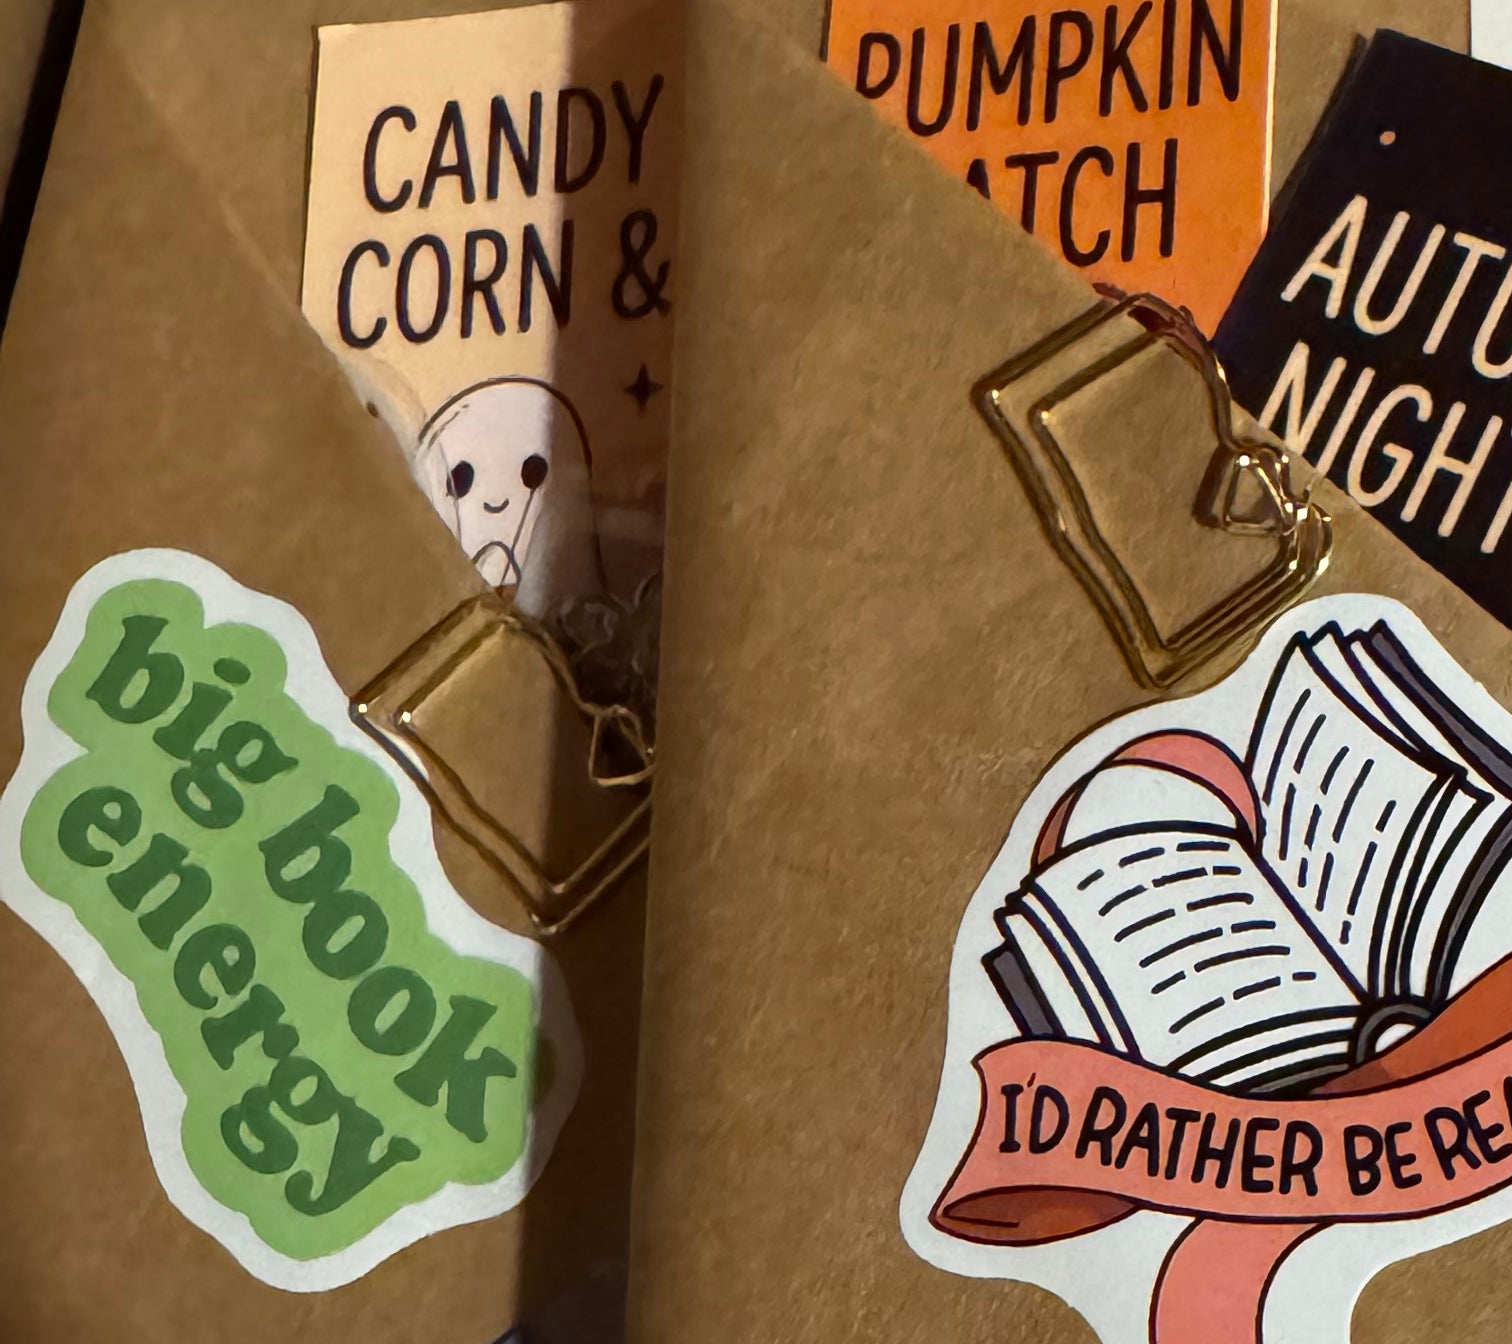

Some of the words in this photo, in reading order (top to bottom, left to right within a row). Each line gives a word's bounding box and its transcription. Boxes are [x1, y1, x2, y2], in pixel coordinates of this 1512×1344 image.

[363, 73, 665, 213] CANDY
[337, 218, 574, 349] CORN
[610, 209, 672, 320] &
[86, 614, 299, 829] big
[258, 784, 518, 1144] book
[57, 786, 421, 1216] energy
[999, 1072, 1070, 1154] I'D
[1075, 1086, 1323, 1196] RATHER
[1343, 1122, 1422, 1197] BE
